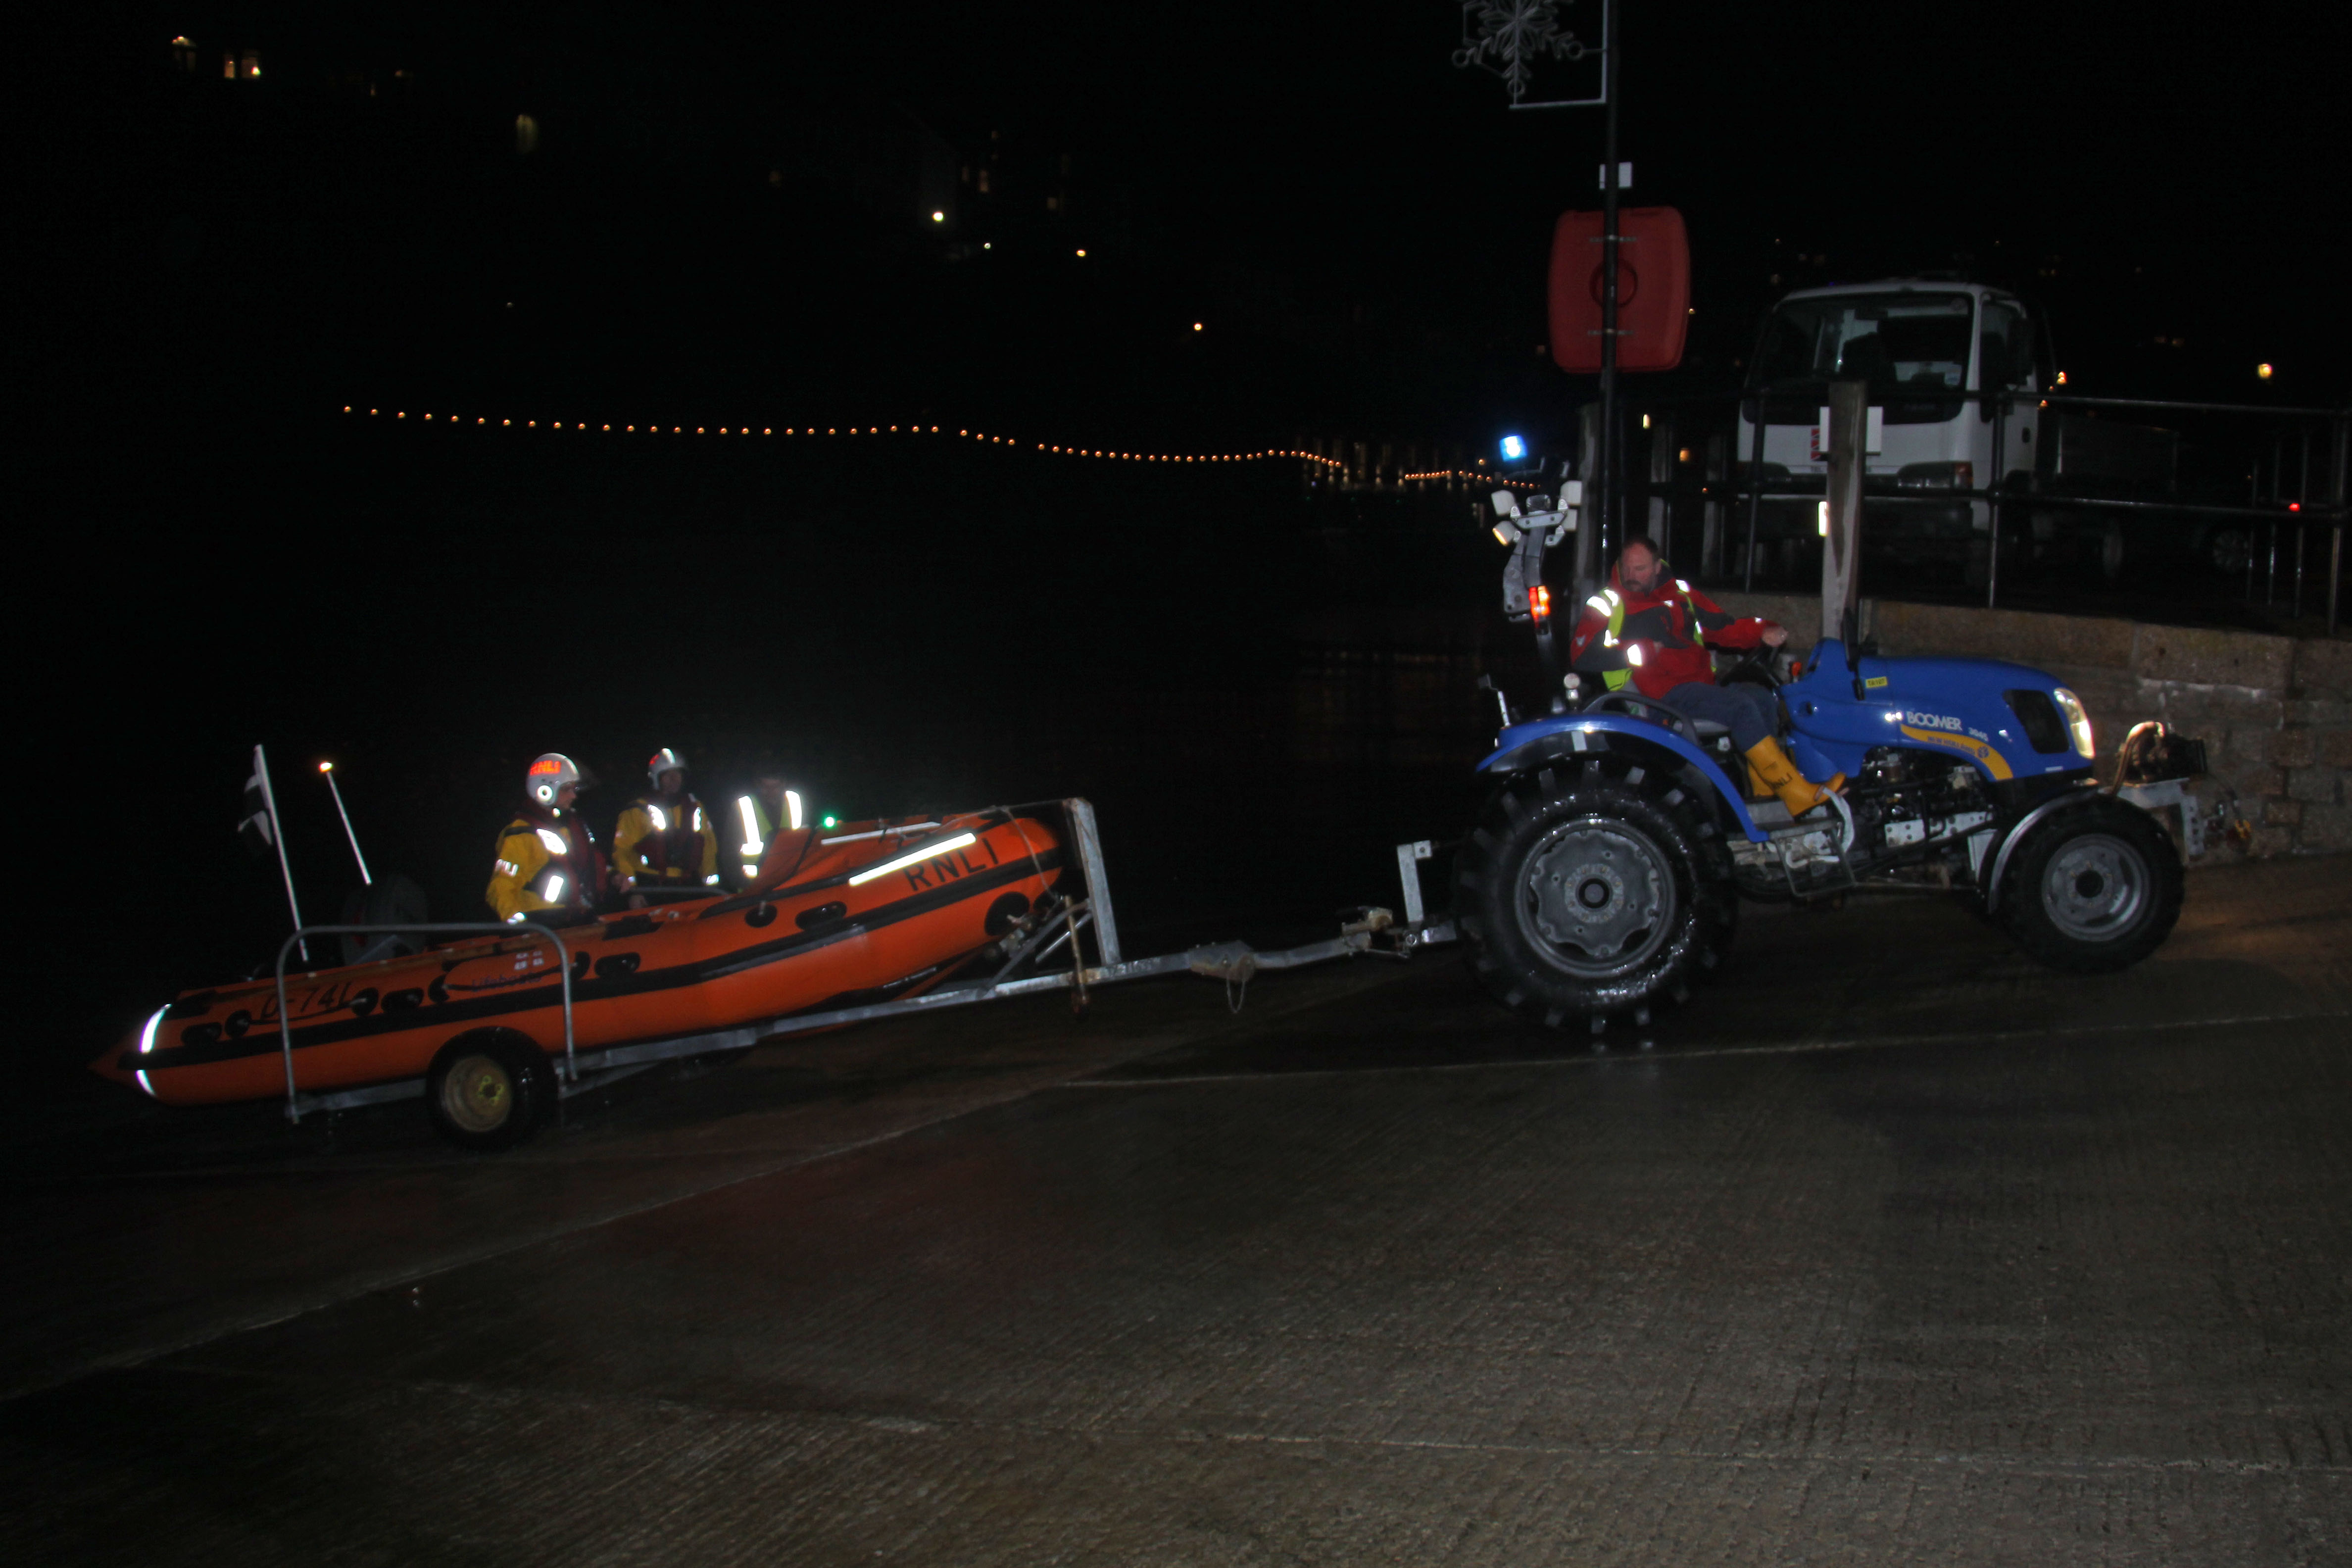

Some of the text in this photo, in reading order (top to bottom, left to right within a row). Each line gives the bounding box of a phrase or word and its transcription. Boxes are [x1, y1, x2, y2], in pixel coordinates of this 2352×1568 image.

[1907, 711, 1963, 731] BOOMER
[529, 760, 561, 776] RNLI
[903, 838, 998, 891] RNLI
